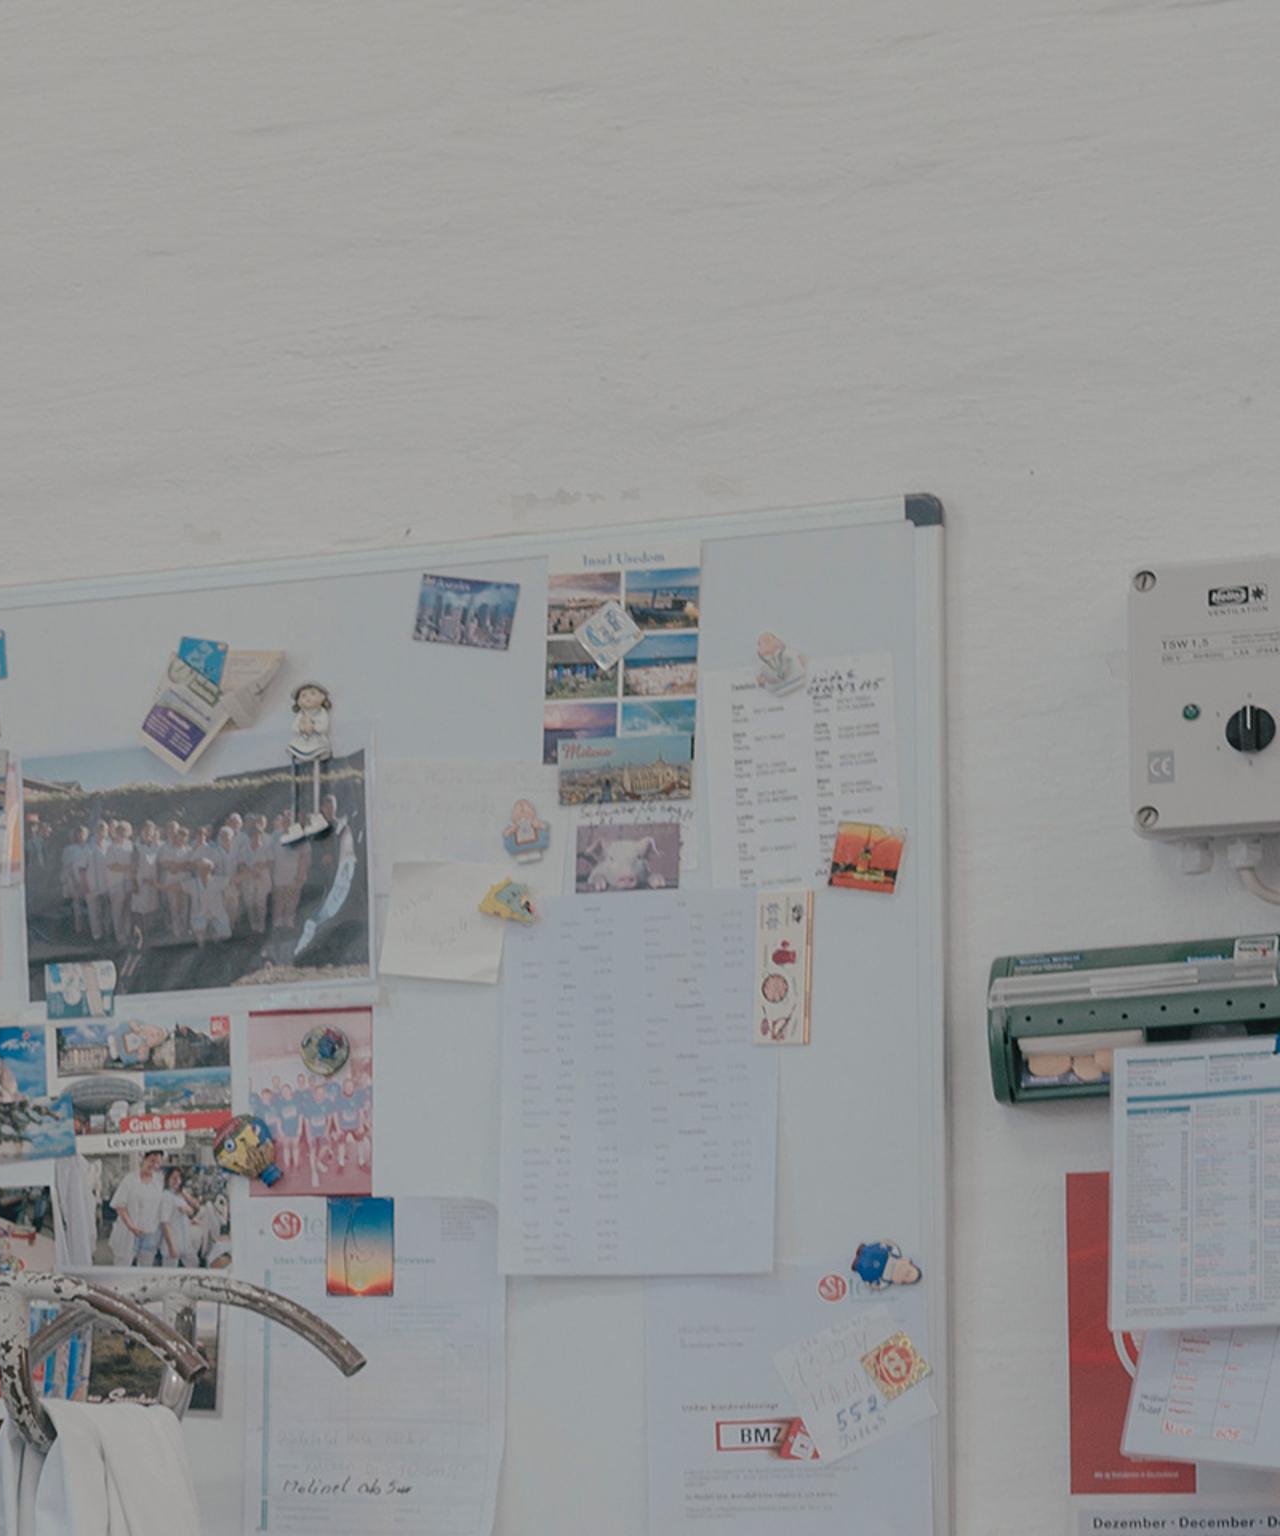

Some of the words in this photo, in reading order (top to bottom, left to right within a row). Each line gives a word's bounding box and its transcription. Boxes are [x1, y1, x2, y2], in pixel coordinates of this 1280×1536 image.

[129, 1117, 162, 1132] Gruß
[164, 1118, 187, 1130] aus
[107, 1134, 178, 1150] Leverkusen
[1092, 1516, 1167, 1530] Dezember
[1178, 1517, 1255, 1529] December
